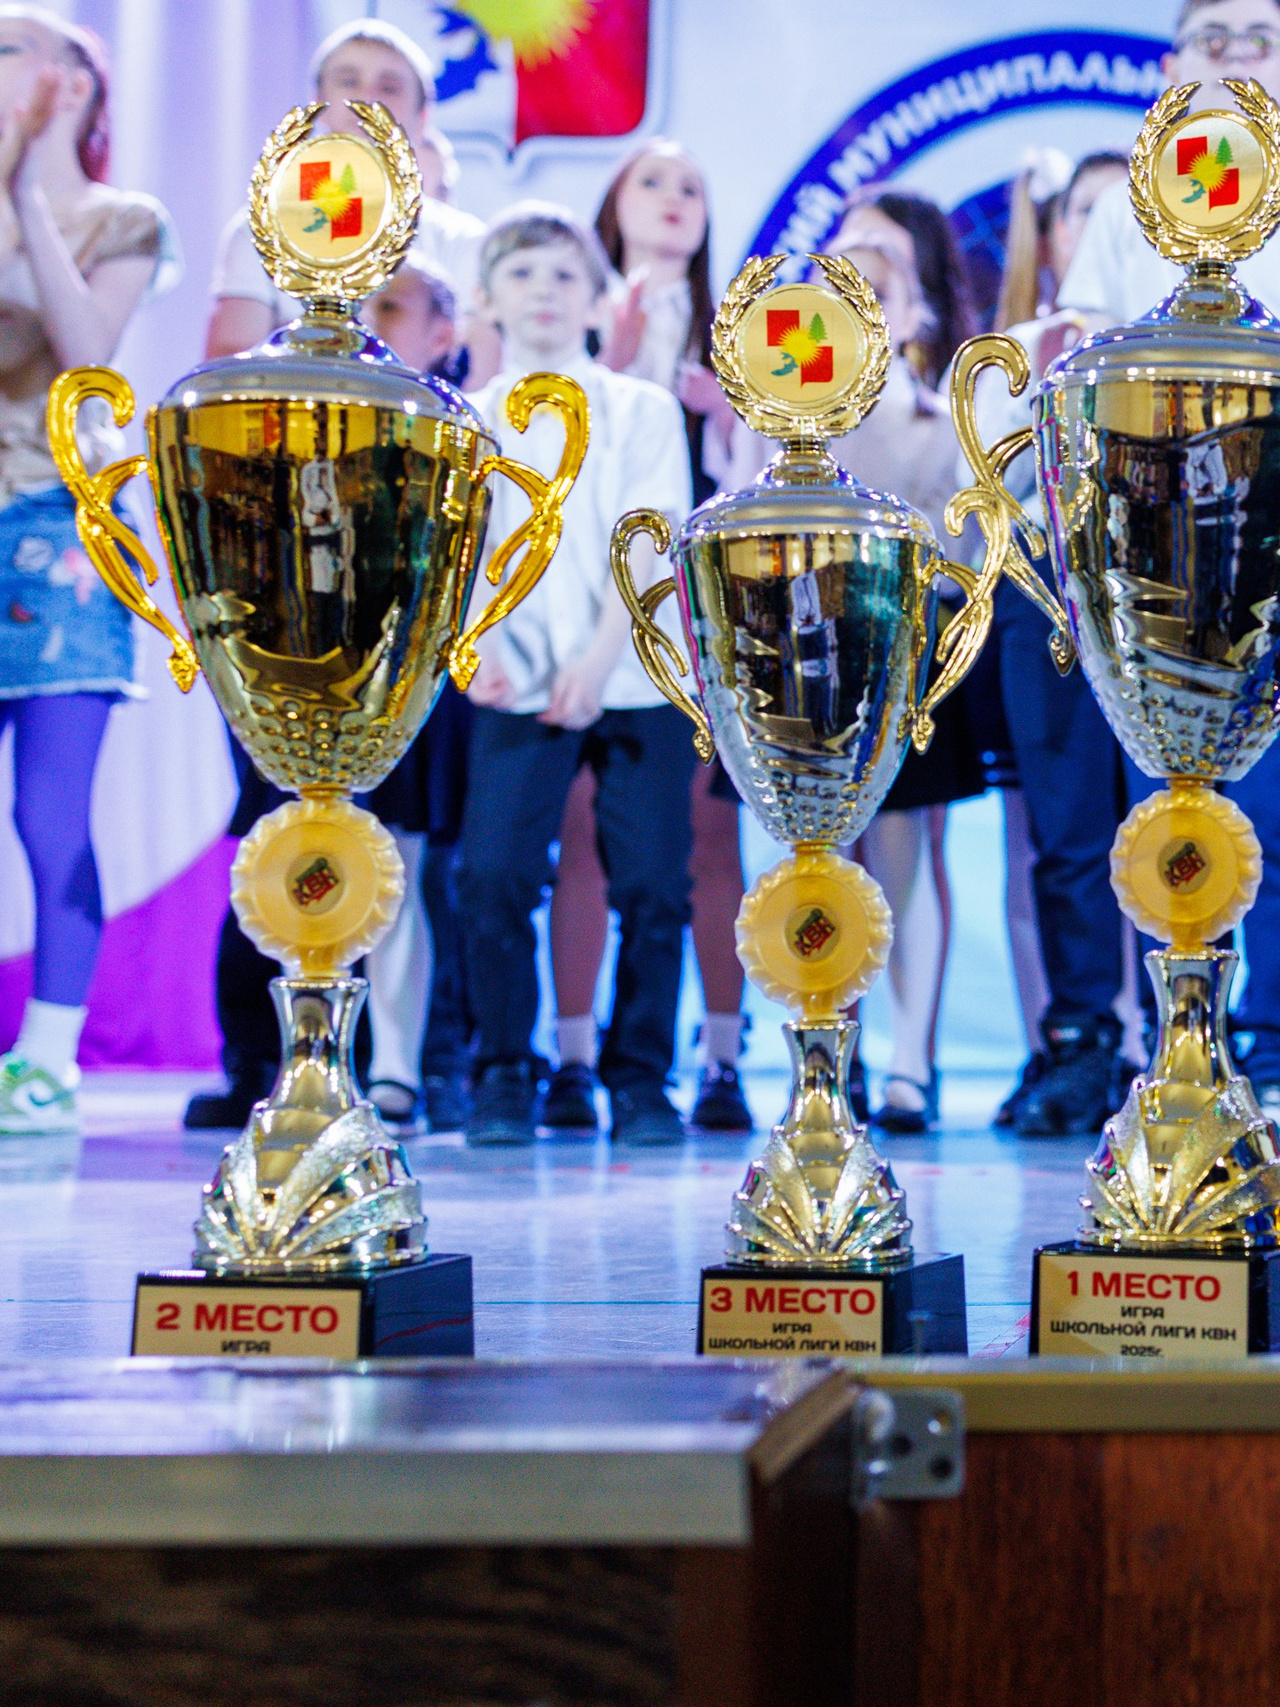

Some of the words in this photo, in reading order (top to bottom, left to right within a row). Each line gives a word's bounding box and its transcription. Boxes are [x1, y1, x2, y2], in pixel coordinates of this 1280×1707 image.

[1067, 1270, 1079, 1297] 1
[1091, 1271, 1221, 1302] МЕСТО
[709, 1286, 733, 1313] 3
[744, 1287, 876, 1315] МЕСТО
[155, 1302, 181, 1331] 2
[194, 1303, 340, 1335] МЕСТО
[1120, 1305, 1165, 1319] ИГРА
[772, 1322, 813, 1334] ИГРА
[1050, 1320, 1146, 1337] ШКОЛЬНОЙ
[1150, 1325, 1196, 1339] ЛИГИ
[1201, 1328, 1237, 1341] КВН
[221, 1339, 271, 1354] ИГРА
[708, 1335, 796, 1351] ШКОЛЬНОЙ
[800, 1339, 840, 1351] ЛИГИ
[844, 1340, 876, 1352] КВН
